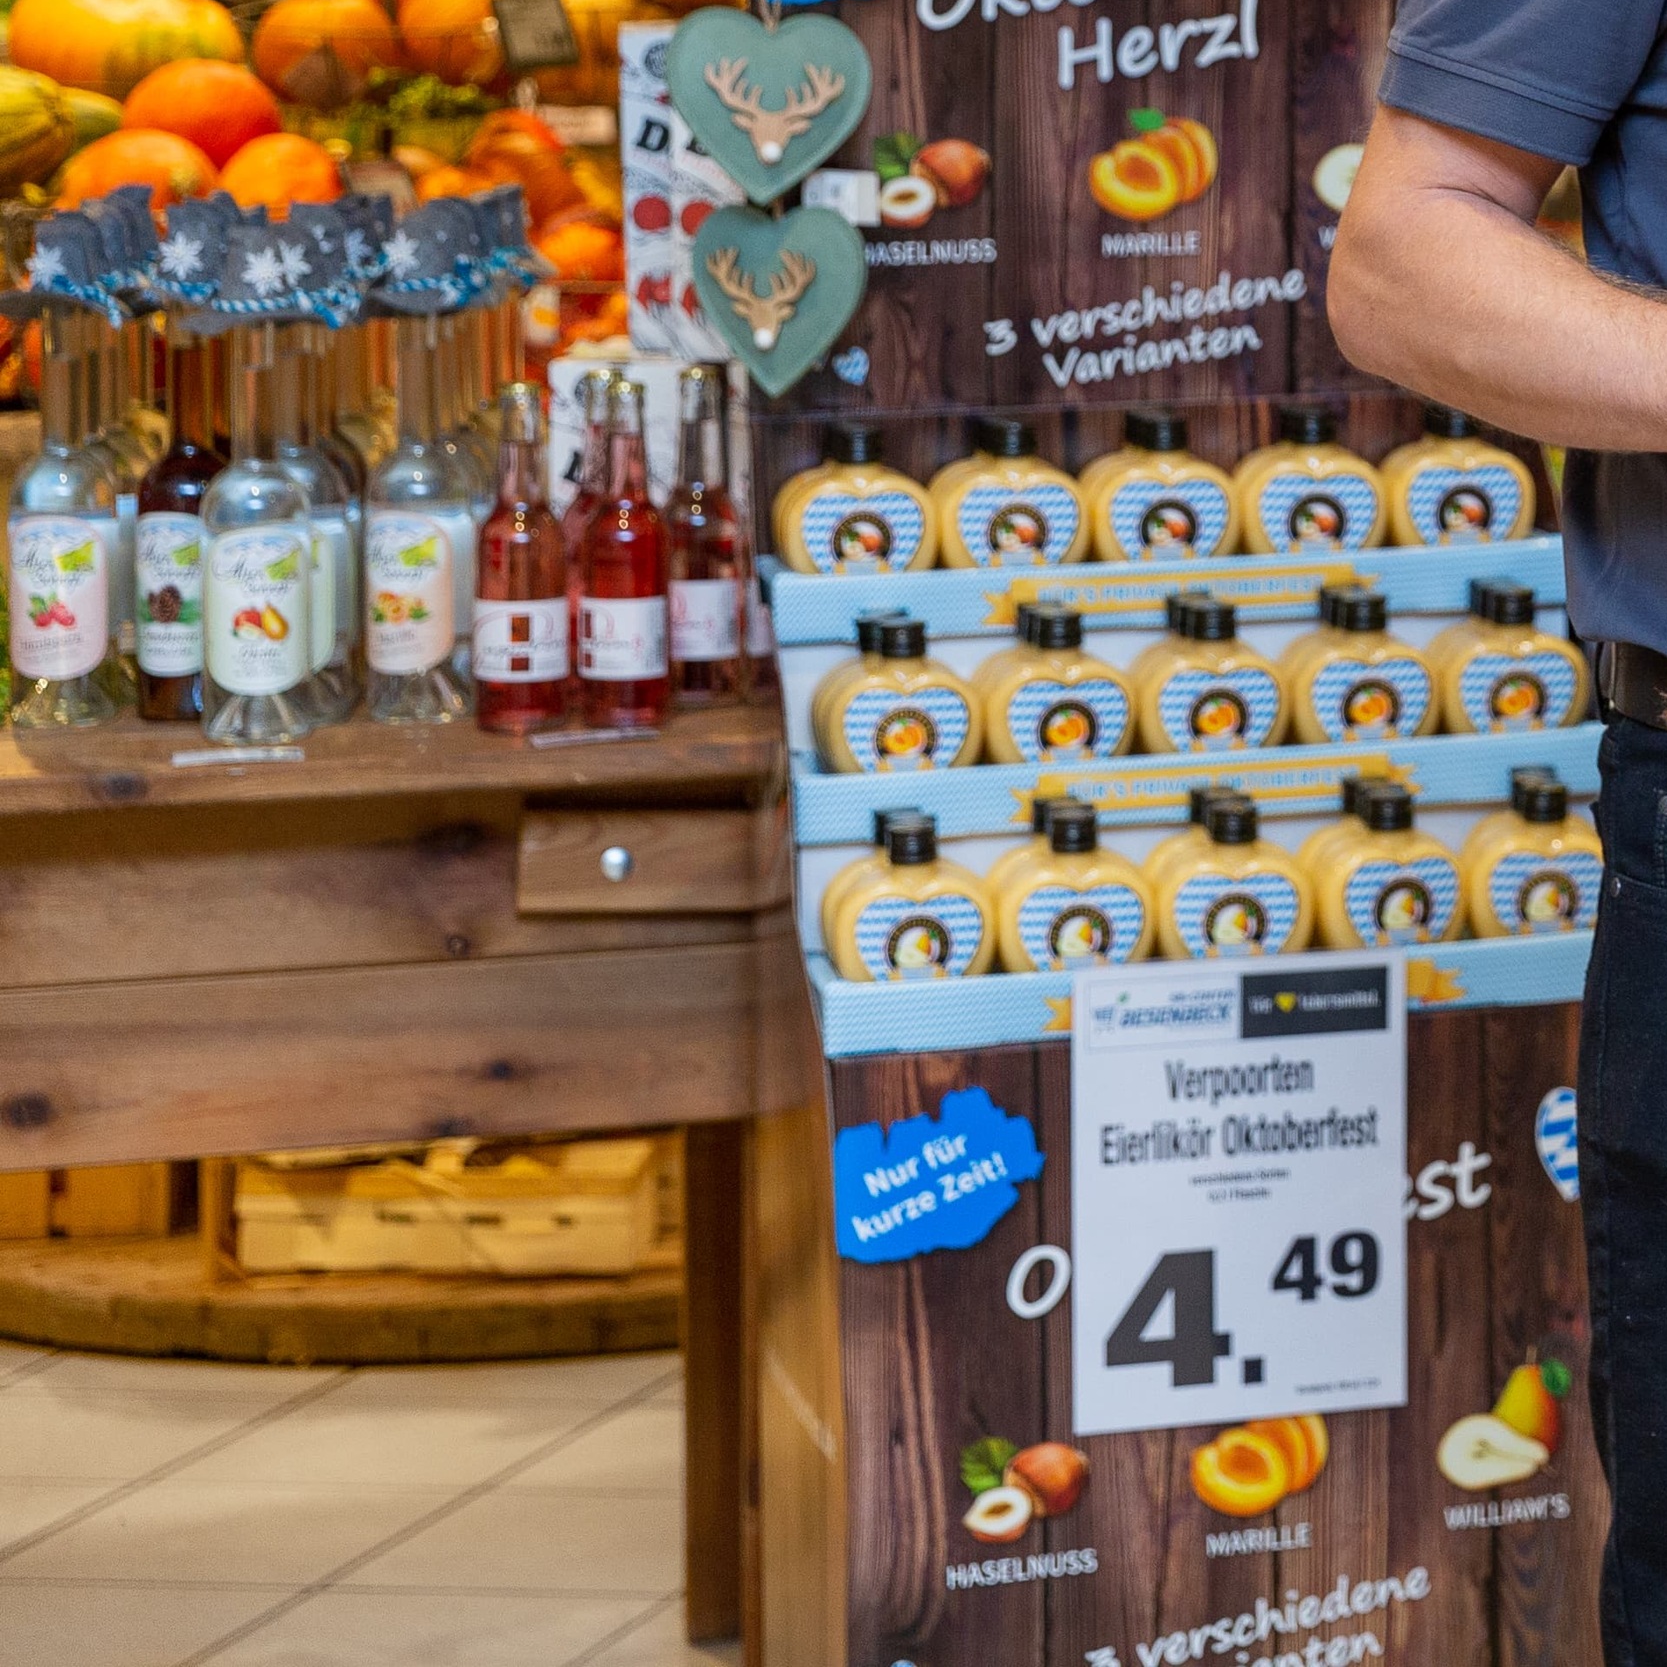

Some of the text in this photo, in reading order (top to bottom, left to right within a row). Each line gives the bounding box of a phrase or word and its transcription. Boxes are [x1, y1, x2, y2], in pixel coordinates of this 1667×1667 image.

[1101, 230, 1201, 258] MARILLE
[984, 267, 1308, 356] 3 verschiedene
[1043, 320, 1262, 389] Varianten
[1164, 1054, 1316, 1106] Verpoorten
[863, 1134, 968, 1198] Nur für
[1101, 1106, 1380, 1166] Eierlikör Oktoberfest
[852, 1151, 1009, 1243] kurze Zeit!
[945, 1493, 1572, 1591] HASELNUSS MARILLE WILLIAM'S
[1135, 1565, 1432, 1667] verschiedene
